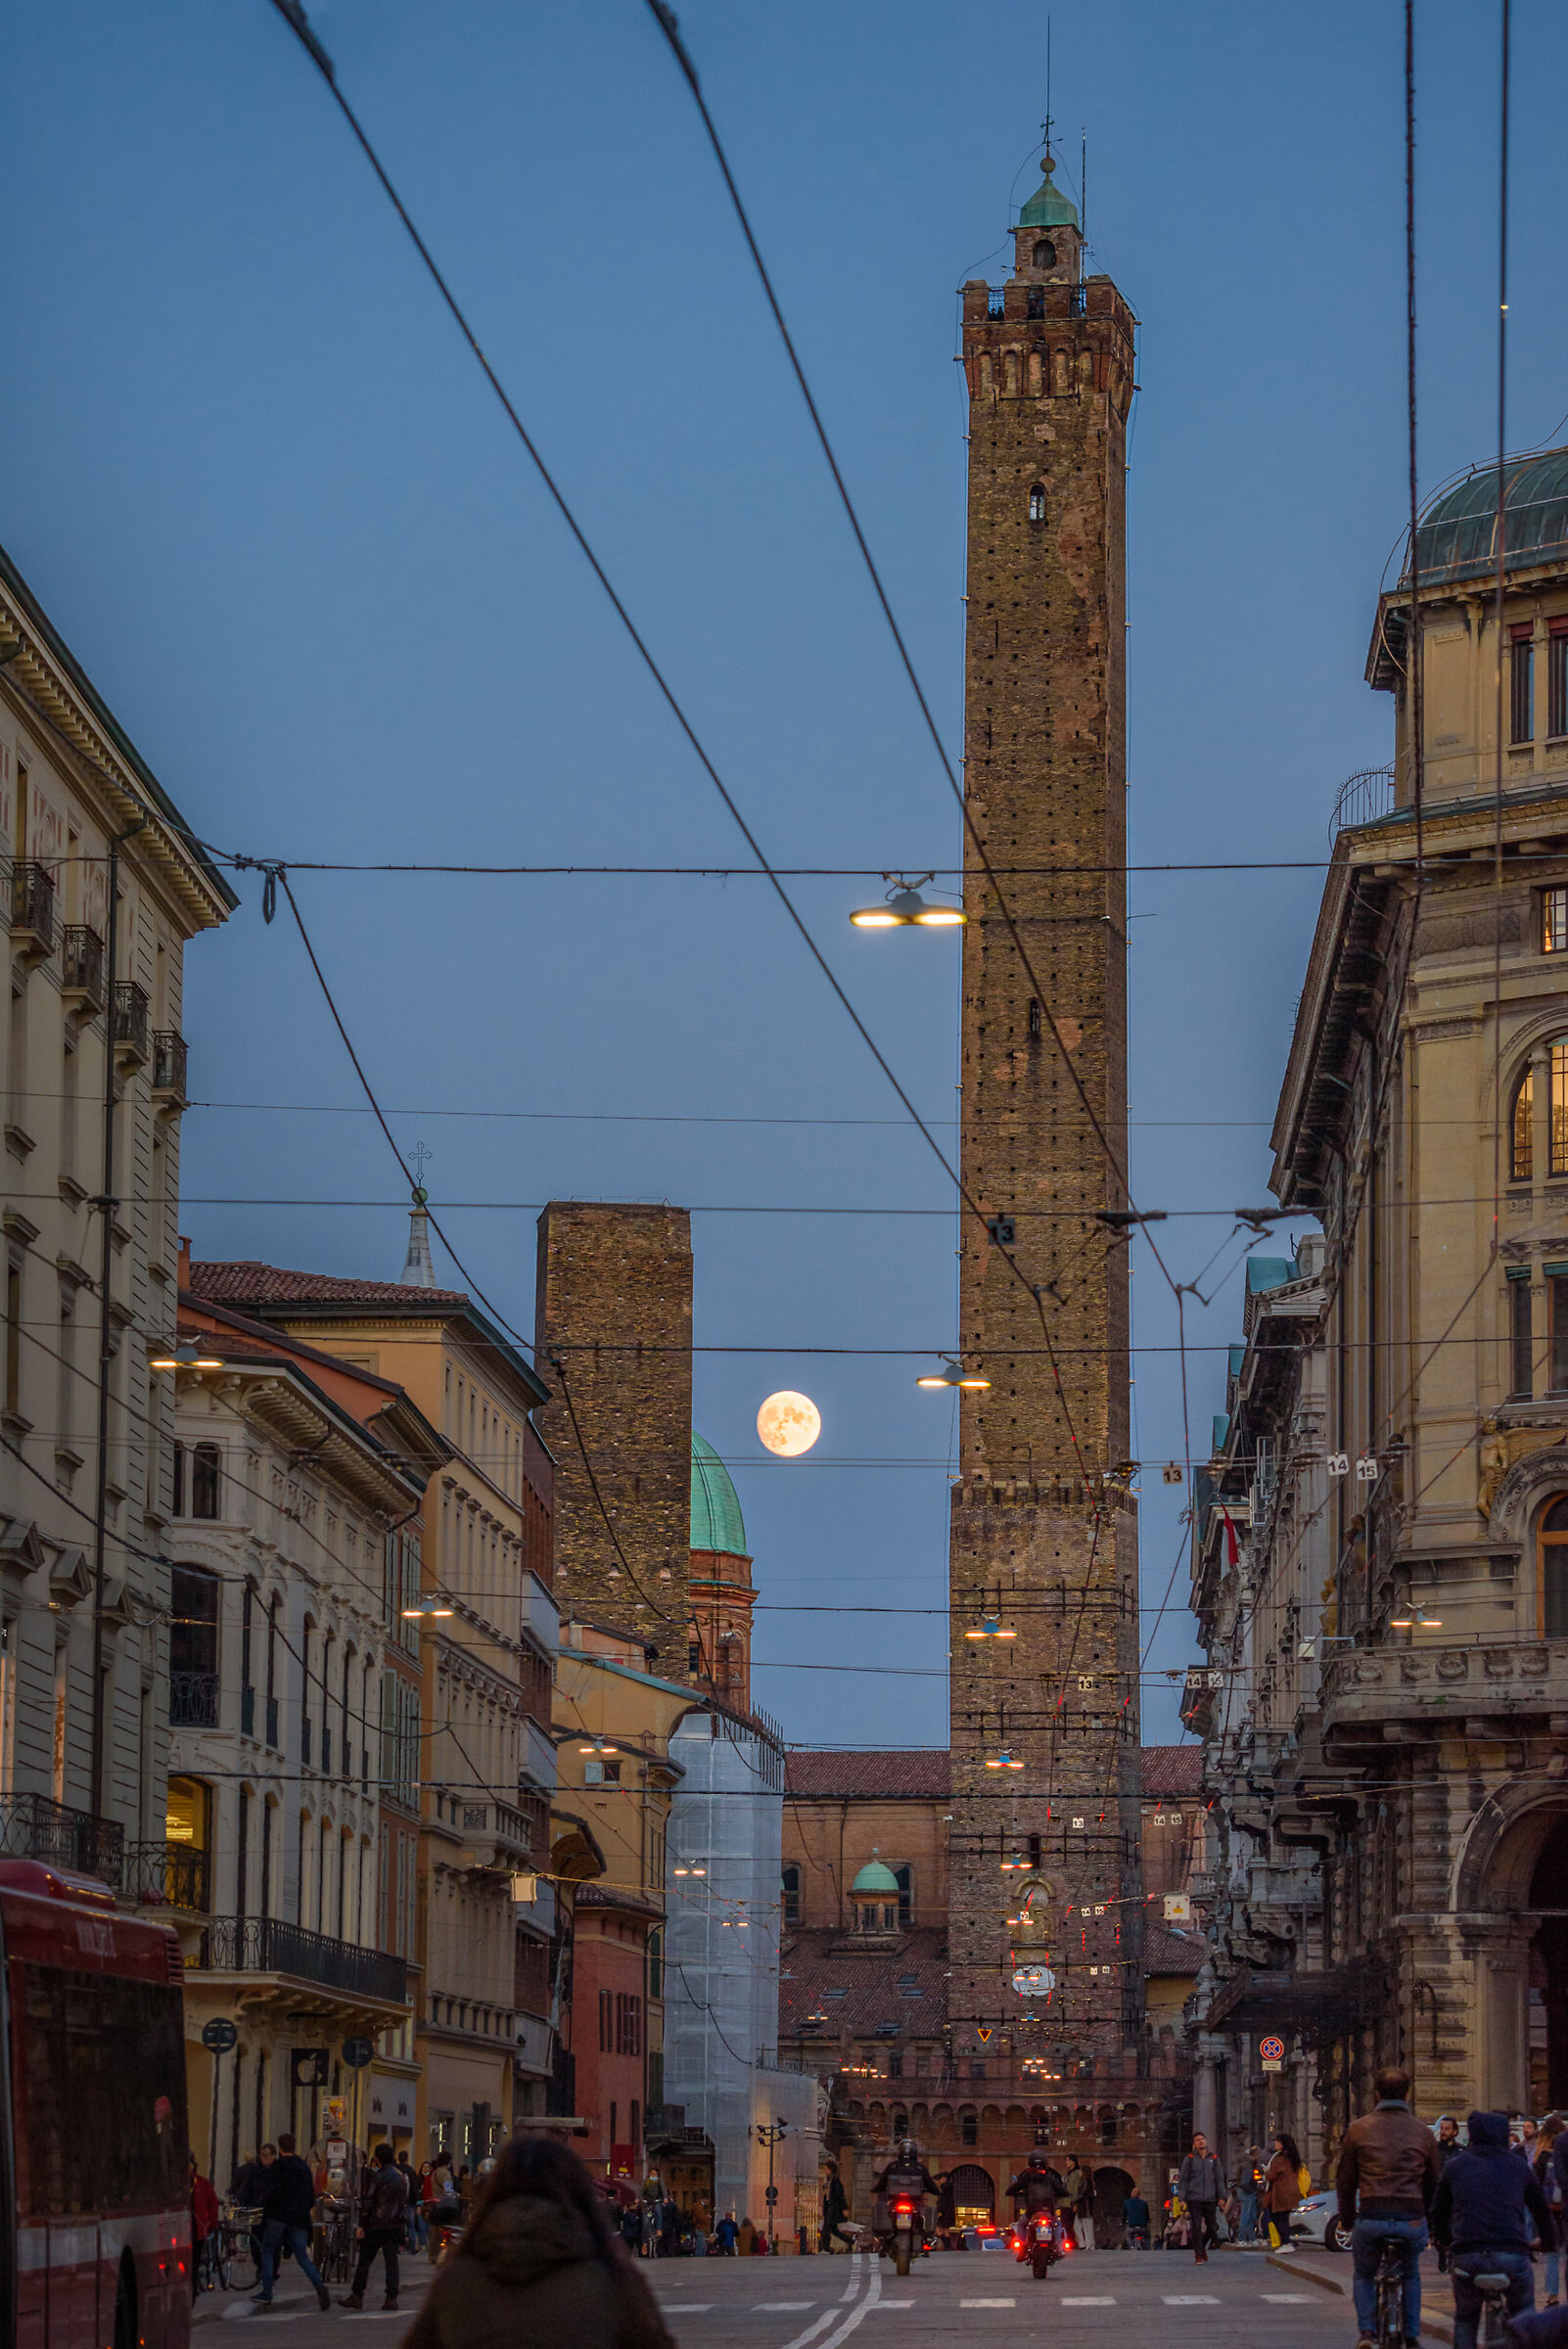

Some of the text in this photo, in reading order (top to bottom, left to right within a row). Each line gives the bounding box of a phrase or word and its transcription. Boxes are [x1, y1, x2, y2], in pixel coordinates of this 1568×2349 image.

[991, 1225, 1013, 1242] 13
[1328, 1460, 1347, 1472] 14
[1358, 1466, 1375, 1478] 15
[1164, 1470, 1182, 1482] 13
[1079, 1681, 1092, 1689] 13
[1187, 1678, 1200, 1686] 14
